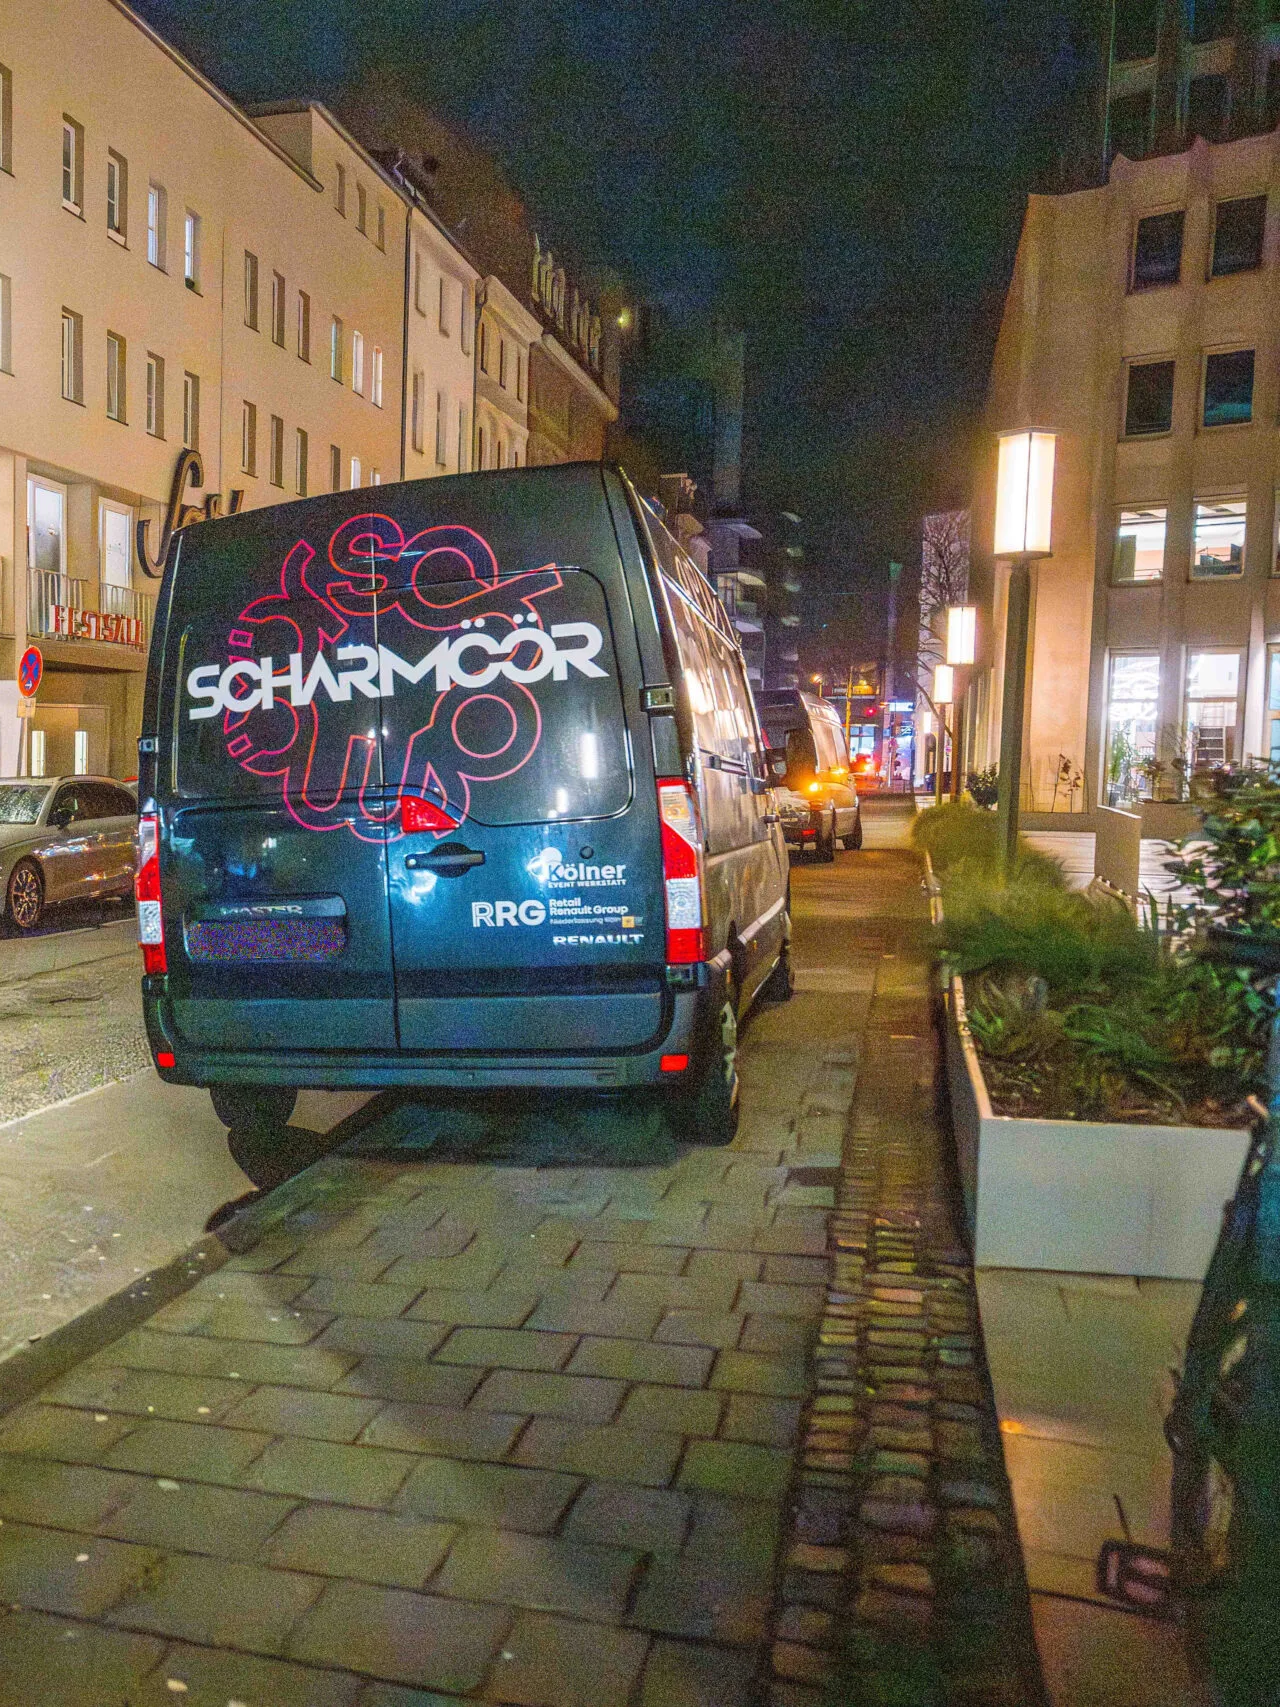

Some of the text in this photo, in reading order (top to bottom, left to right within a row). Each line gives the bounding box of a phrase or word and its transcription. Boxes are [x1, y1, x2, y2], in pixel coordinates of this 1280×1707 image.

[546, 862, 627, 881] Kölner
[548, 879, 627, 889] EVENT WERKSTATT
[549, 897, 582, 907] Retail
[471, 899, 546, 928] RRG
[550, 904, 629, 917] Renault Group
[553, 934, 645, 946] RENAULT
